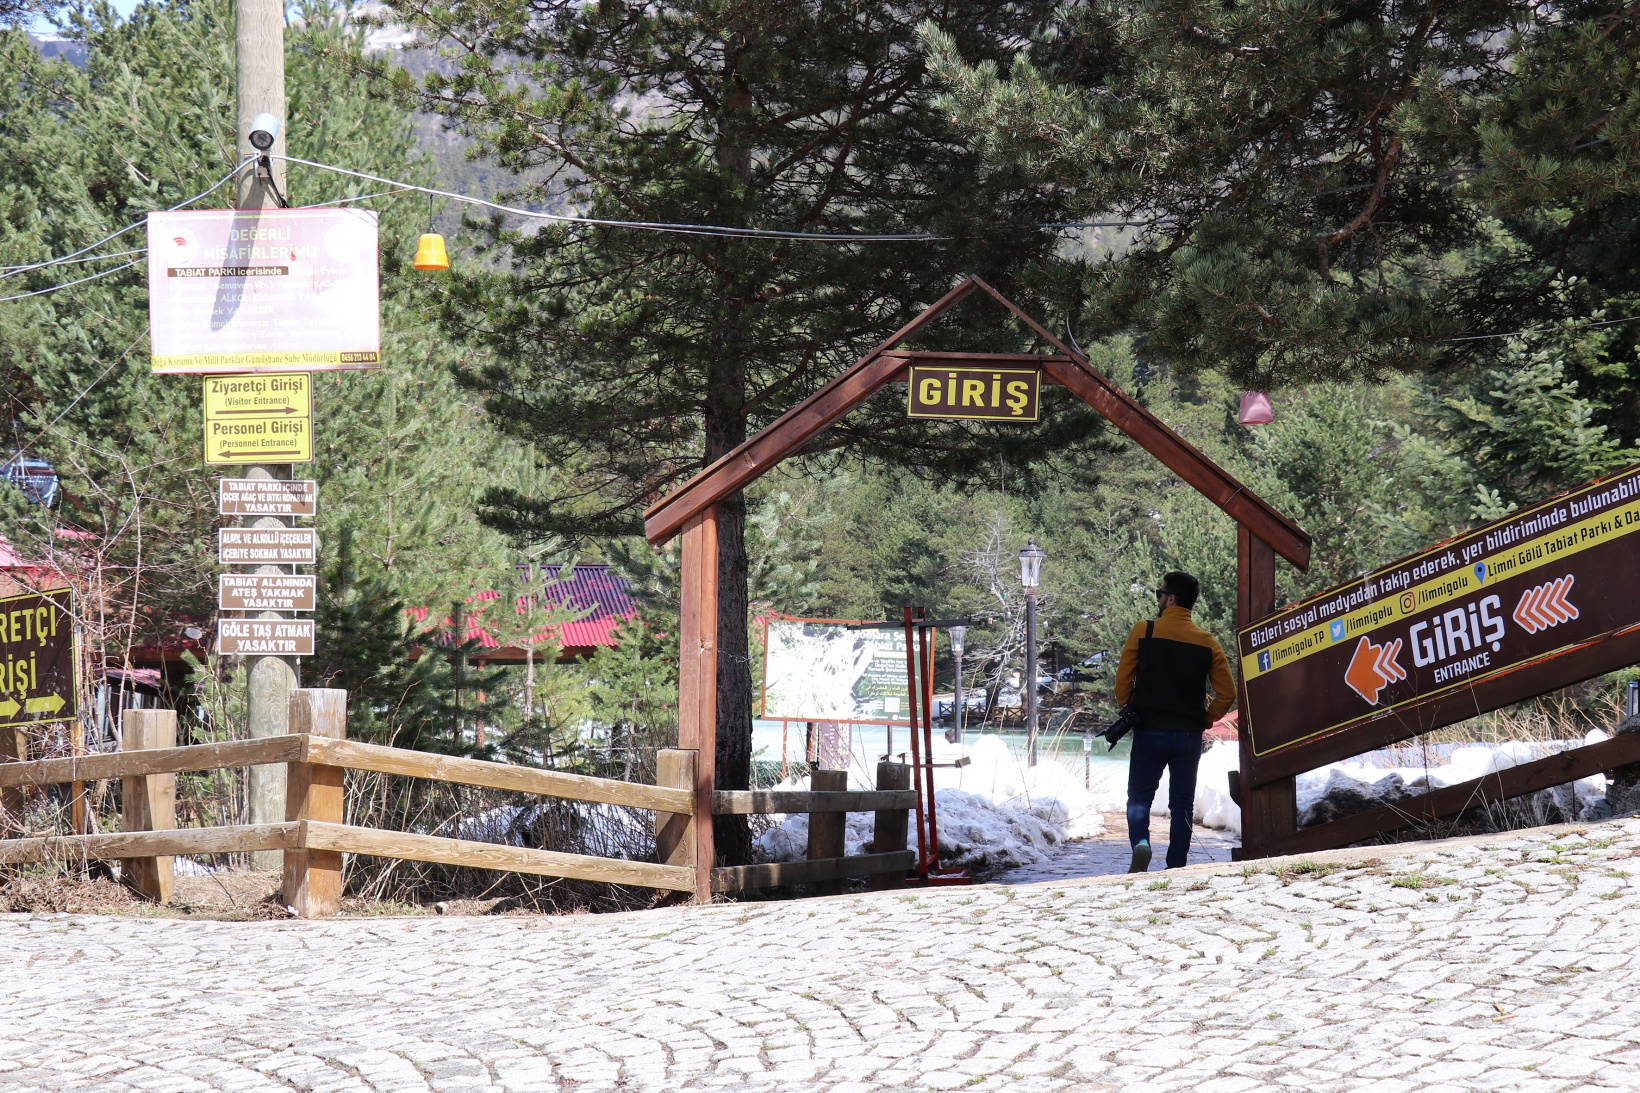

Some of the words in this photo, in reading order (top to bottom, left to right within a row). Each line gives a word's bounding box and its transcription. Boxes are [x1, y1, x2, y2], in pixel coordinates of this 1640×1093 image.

[231, 227, 291, 241] DEĞERLİ
[204, 245, 319, 260] MİSAFİRLERİMİZ
[208, 267, 236, 276] PARKI
[168, 357, 193, 366] Koruma
[194, 357, 202, 365] Ve
[204, 356, 219, 364] Milli
[220, 355, 244, 364] Parklar
[212, 379, 266, 395] Ziyaretçi
[271, 378, 303, 394] Girişi
[918, 372, 1029, 415] GİRİŞ
[225, 397, 251, 407] (Visitor
[254, 396, 290, 406] Entrance)
[213, 421, 266, 435] Personel
[271, 420, 303, 436] Girişi
[220, 439, 259, 449] (Personnel
[261, 438, 297, 447] Entrance)
[258, 482, 282, 491] PARKI
[257, 493, 266, 502] VE
[282, 493, 313, 502] KOPARMAK
[244, 503, 292, 512] YASAKTIR
[243, 533, 252, 544] VE
[1487, 554, 1516, 577] Limni
[1518, 545, 1542, 565] Gölü
[1544, 532, 1578, 555] Tabiat
[1580, 521, 1612, 542] Parkı
[1614, 515, 1623, 529] &
[249, 548, 278, 559] SOKMAK
[280, 548, 312, 559] YASAKTIR
[261, 578, 313, 587] ALANINDA
[1250, 622, 1283, 648] Bizleri
[1283, 608, 1318, 633] sosyal
[1319, 584, 1378, 619] medyadan
[1379, 570, 1410, 592] takip
[1413, 550, 1461, 580] ederek,
[1462, 541, 1484, 565] yer
[1486, 507, 1567, 551] bildiriminde
[231, 588, 258, 599] ATEŞ
[260, 588, 304, 597] YAKMAK
[242, 598, 293, 608] YASAKTIR
[222, 622, 250, 637] GÖLE
[252, 624, 272, 639] TAŞ
[274, 624, 311, 637] ATMAK
[1313, 630, 1325, 645] TP
[237, 640, 297, 651] YASAKTIR
[1433, 651, 1491, 683] ENTRANCE
